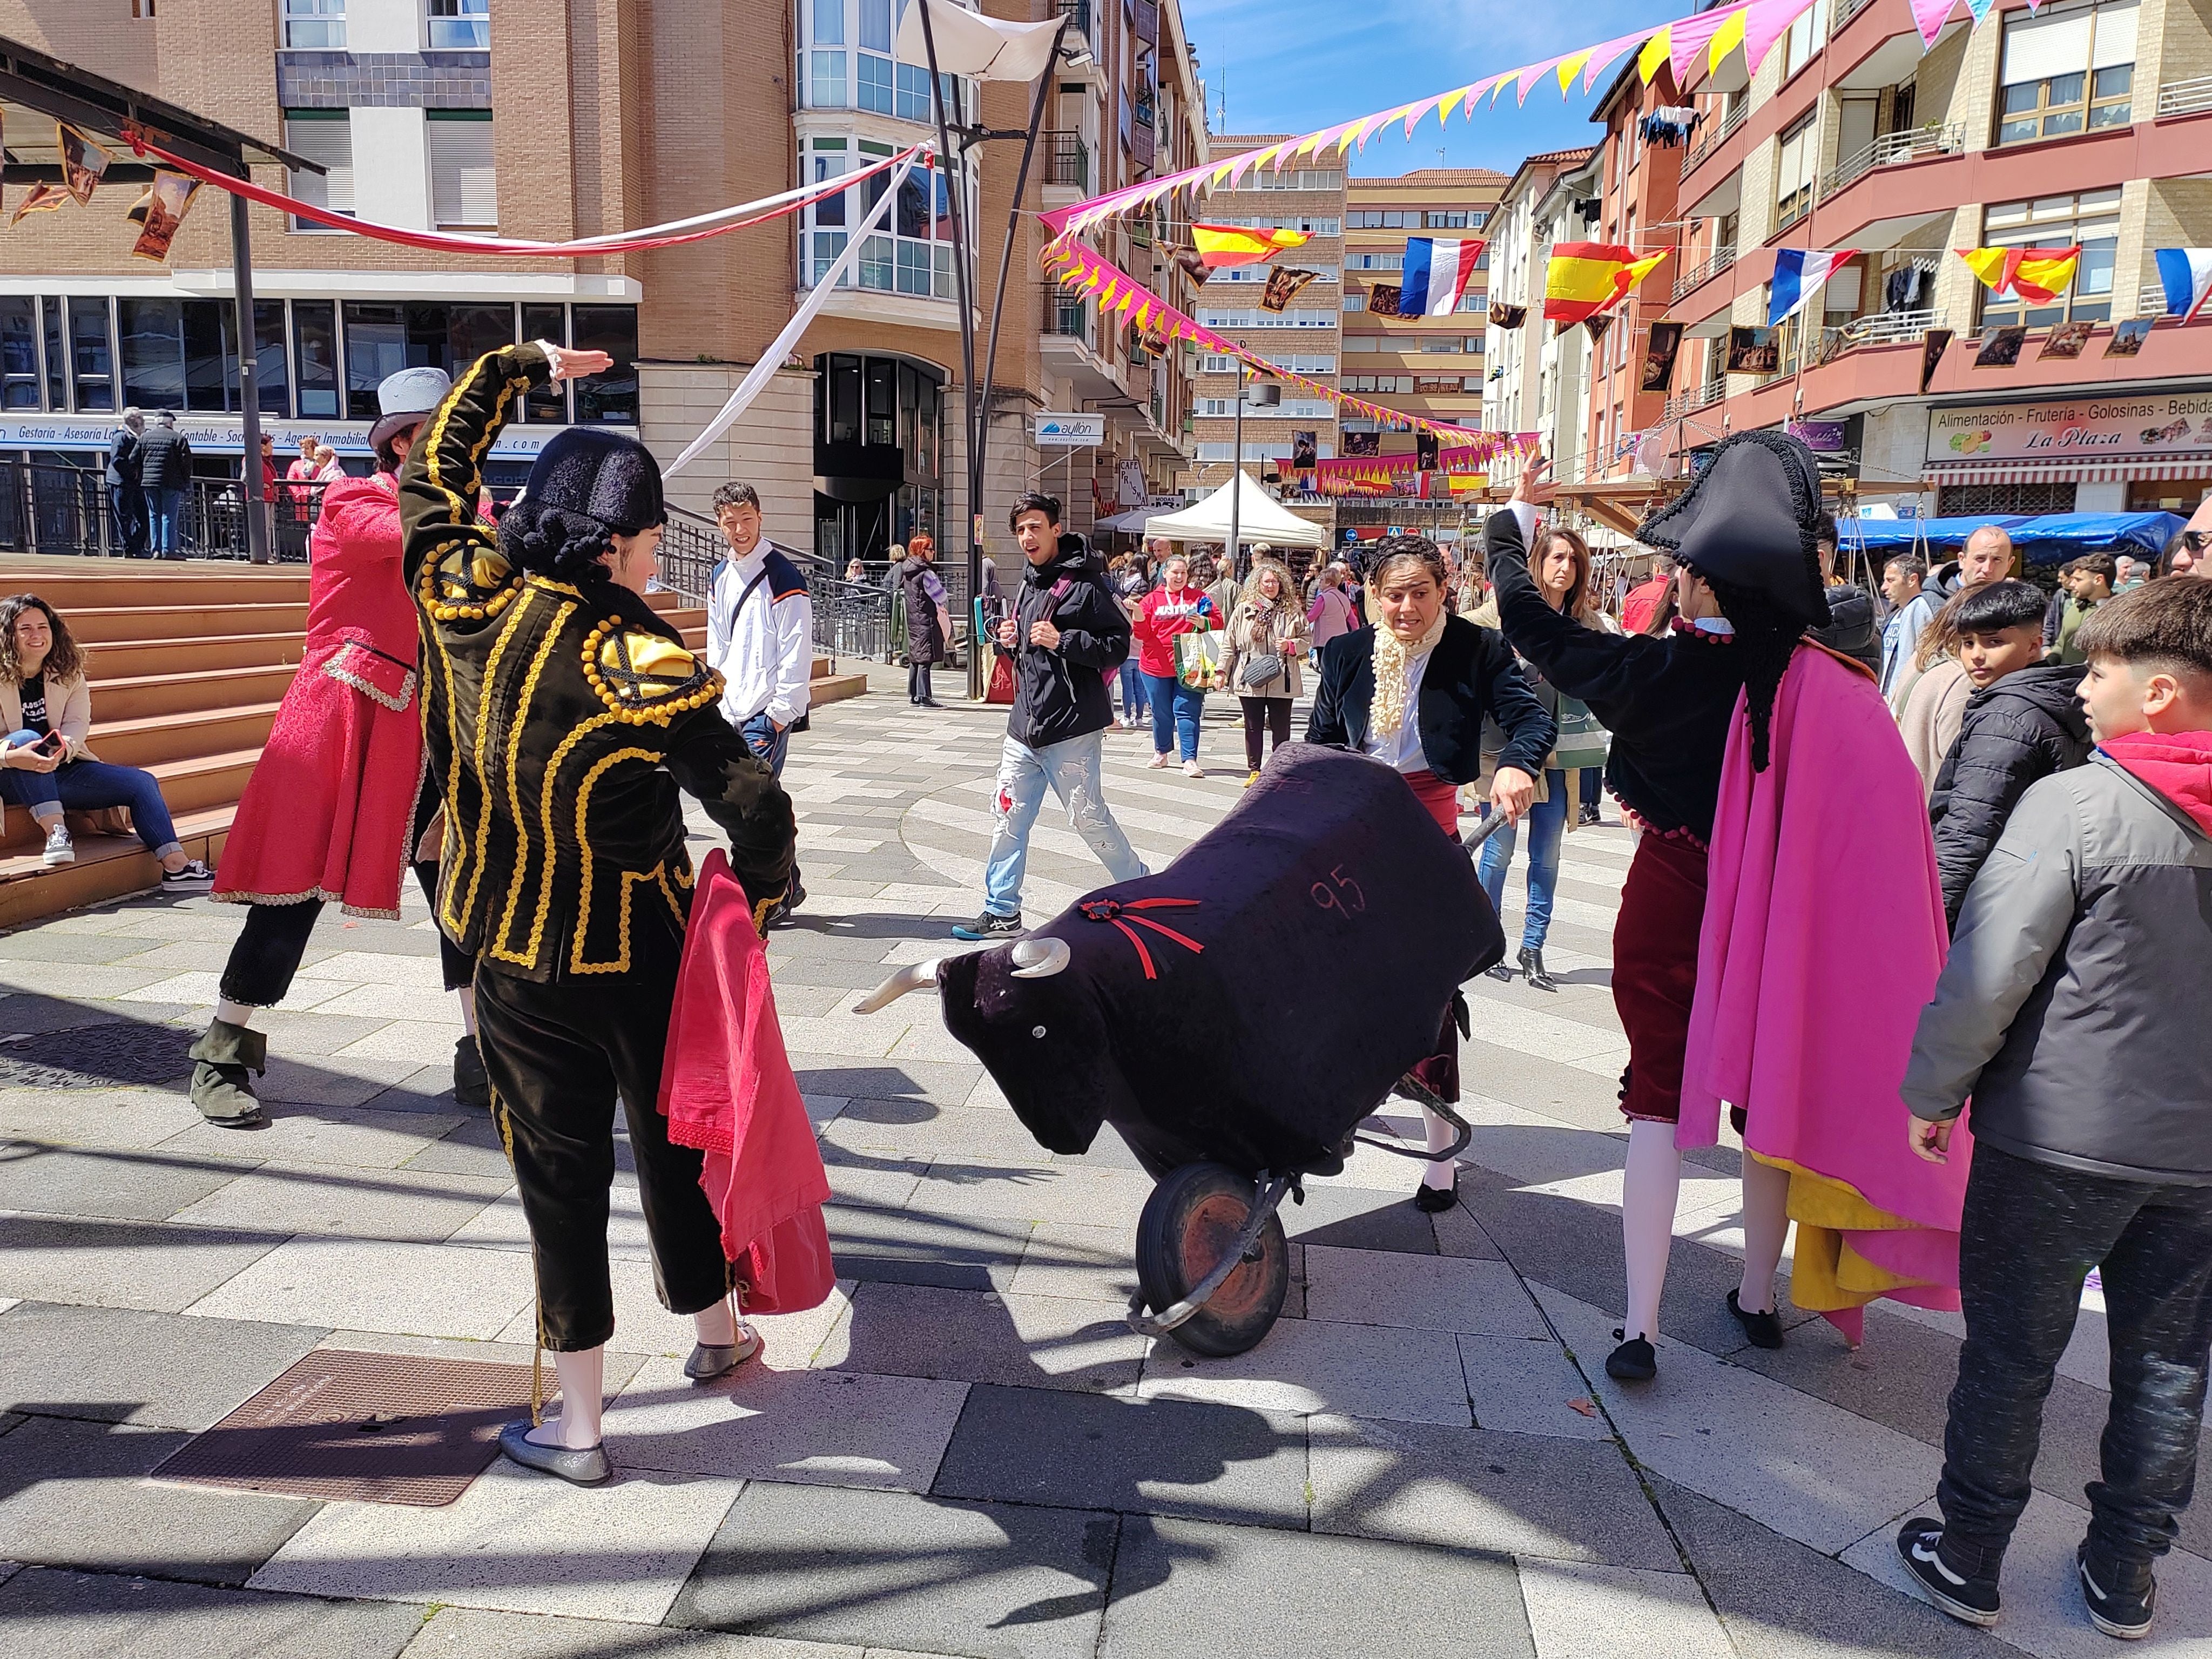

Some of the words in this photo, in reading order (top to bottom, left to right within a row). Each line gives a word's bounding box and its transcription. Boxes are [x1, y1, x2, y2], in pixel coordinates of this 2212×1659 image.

[1938, 410, 2014, 428] Alimentación
[2027, 407, 2074, 423] Frutería
[2088, 402, 2154, 420] Golosinas
[19, 426, 55, 439] Gestoría
[64, 427, 100, 440] Asesoría
[2023, 431, 2052, 448] La
[2058, 427, 2121, 447] Plaza
[1121, 461, 1138, 469] CAFE
[1311, 864, 1365, 919] 95
